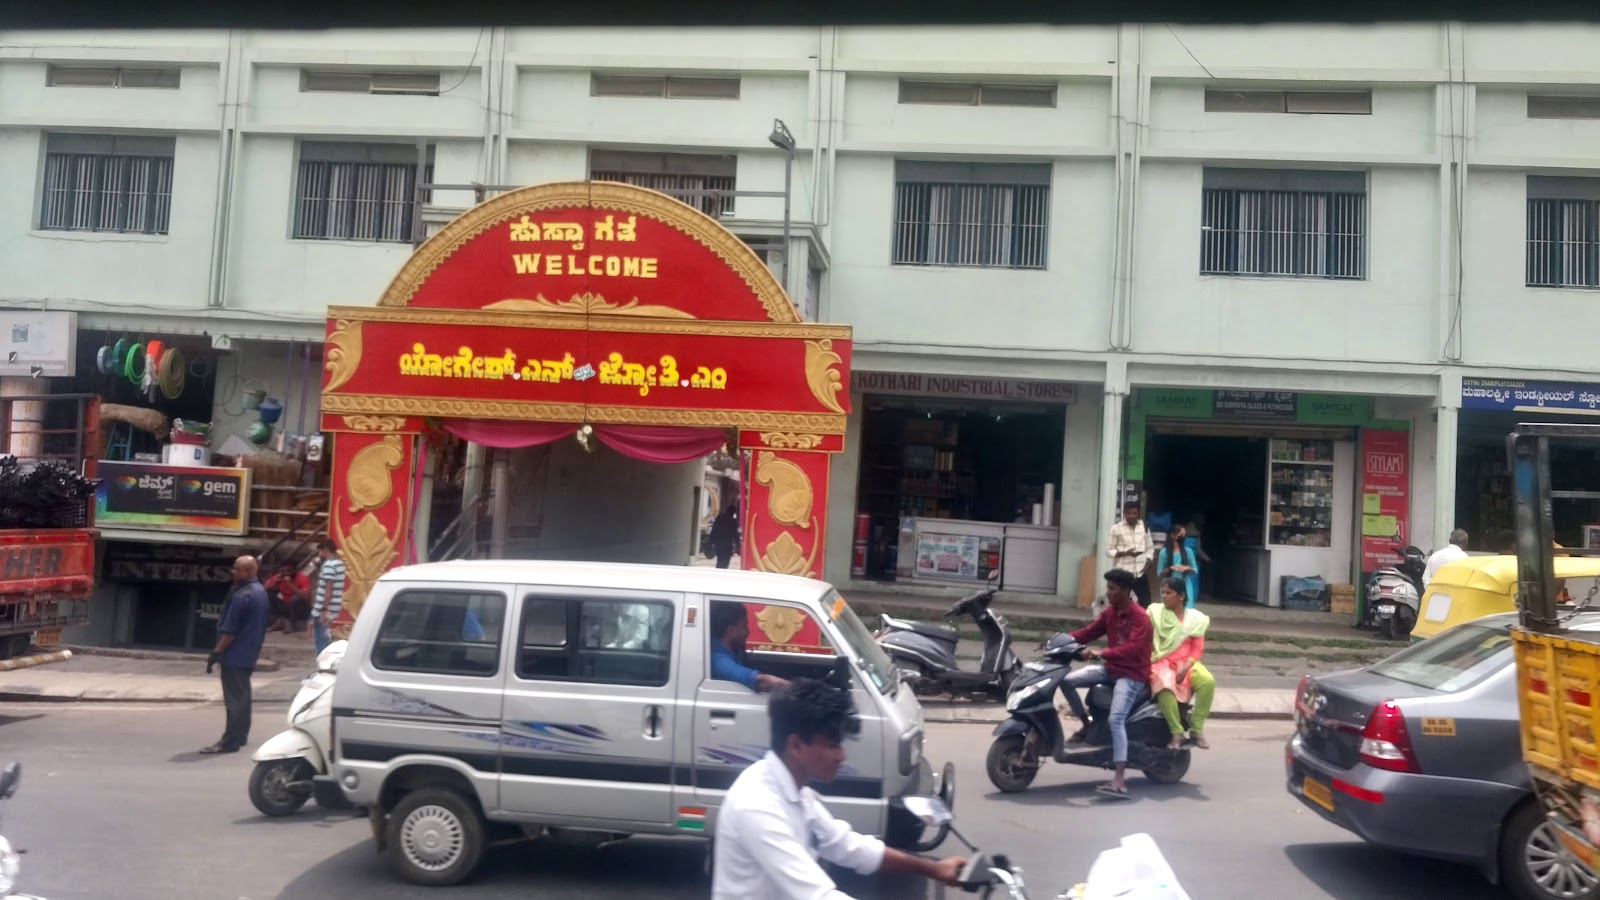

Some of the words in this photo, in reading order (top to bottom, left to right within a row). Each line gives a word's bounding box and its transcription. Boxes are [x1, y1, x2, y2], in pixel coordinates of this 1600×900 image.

[512, 253, 658, 278] WELCOME
[858, 372, 922, 391] KOTHARI
[927, 377, 1013, 395] INDUSTRIAL
[1017, 382, 1073, 399] STORES
[1370, 455, 1400, 471] STYLAM
[203, 480, 236, 496] gem
[0, 547, 63, 577] HER
